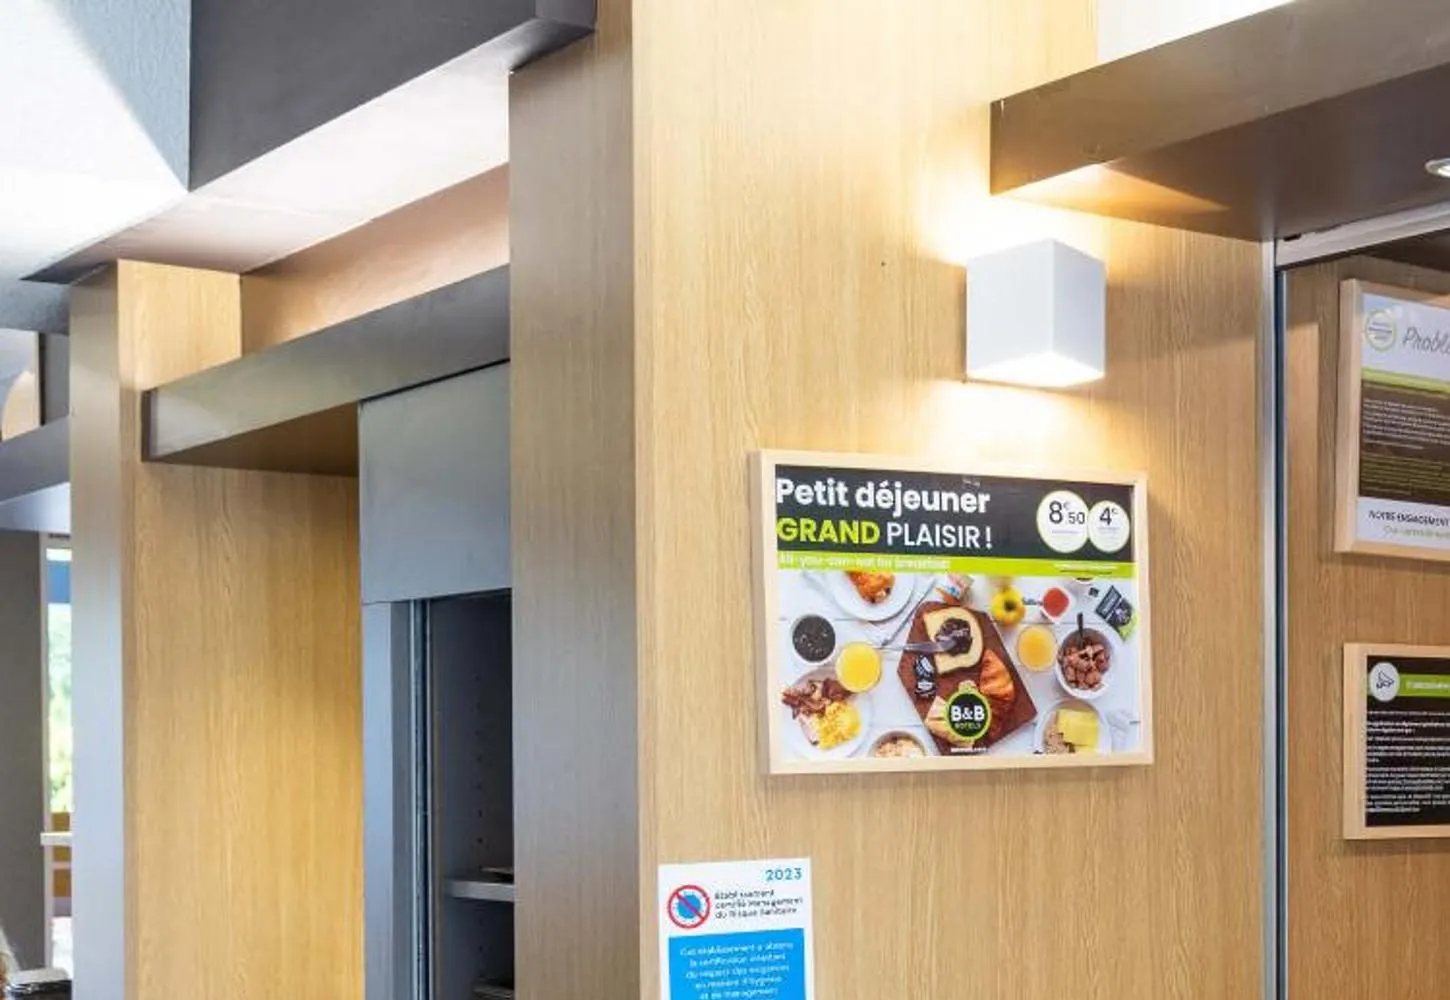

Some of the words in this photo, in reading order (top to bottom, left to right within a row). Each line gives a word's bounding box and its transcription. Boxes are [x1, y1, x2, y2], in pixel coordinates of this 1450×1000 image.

[776, 478, 849, 507] Petit
[855, 480, 991, 518] déjeuner
[776, 518, 881, 545] GRAND
[887, 521, 981, 549] PLAISIR
[950, 705, 985, 721] B&B
[764, 867, 803, 882] 2023
